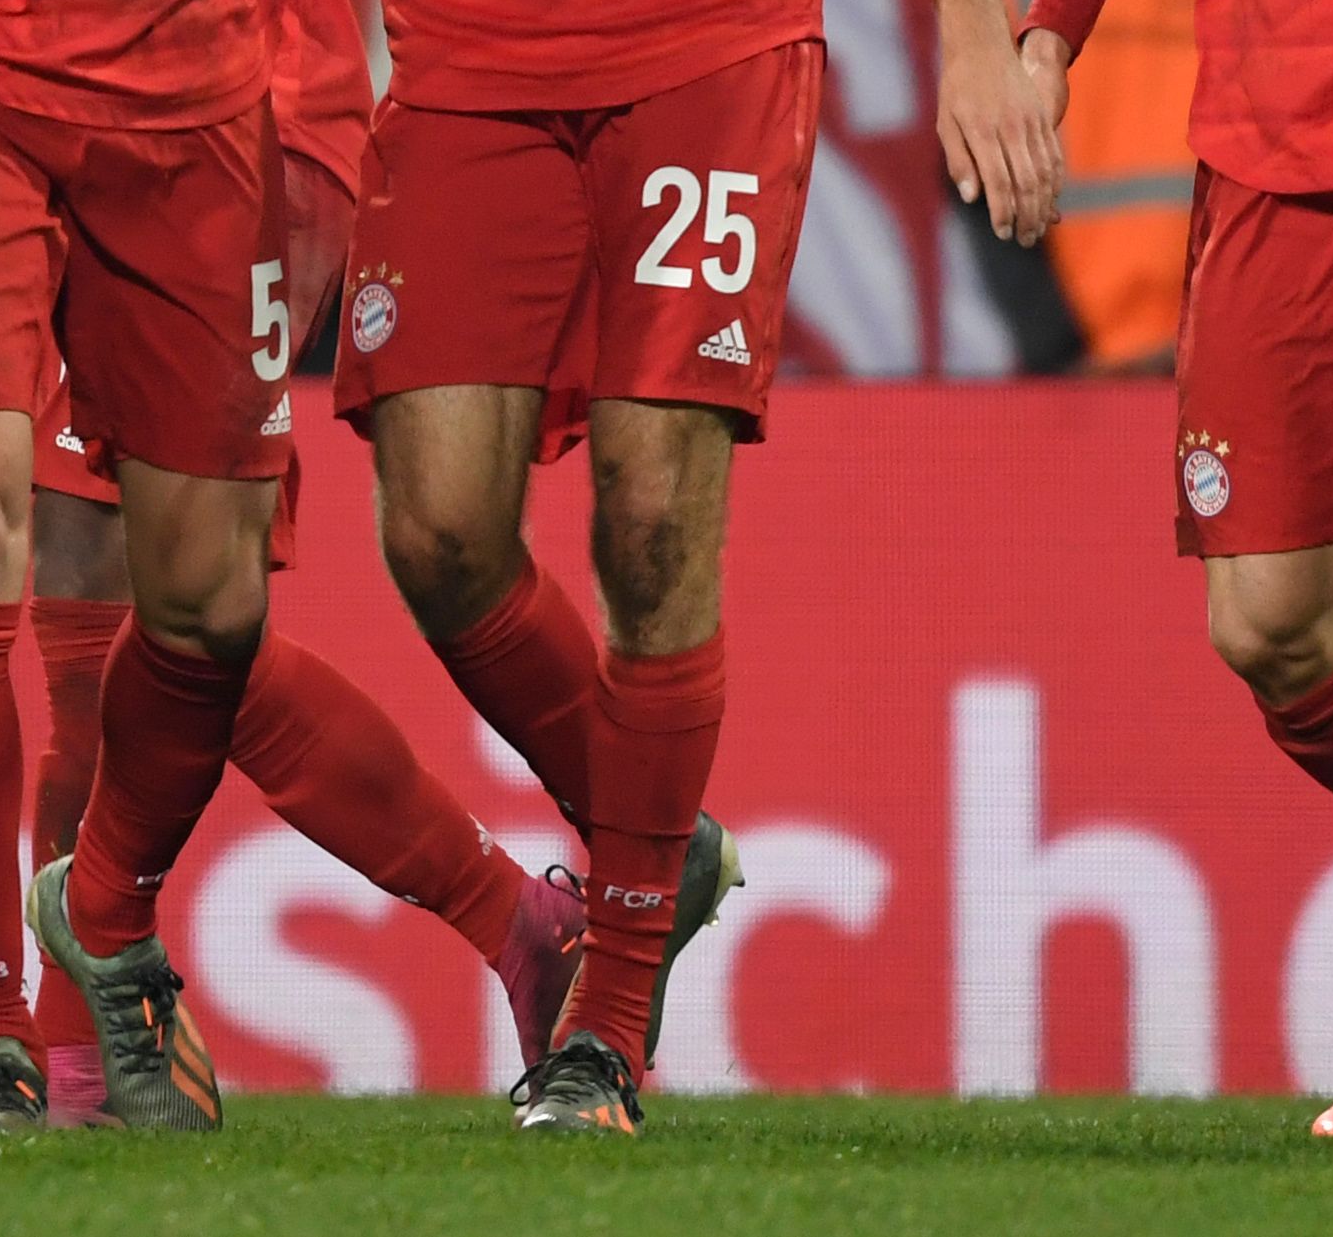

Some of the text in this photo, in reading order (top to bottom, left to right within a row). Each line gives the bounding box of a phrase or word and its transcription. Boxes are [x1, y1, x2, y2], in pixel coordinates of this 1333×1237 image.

[633, 165, 760, 295] 25
[250, 258, 291, 382] 5
[604, 884, 663, 909] FCB
